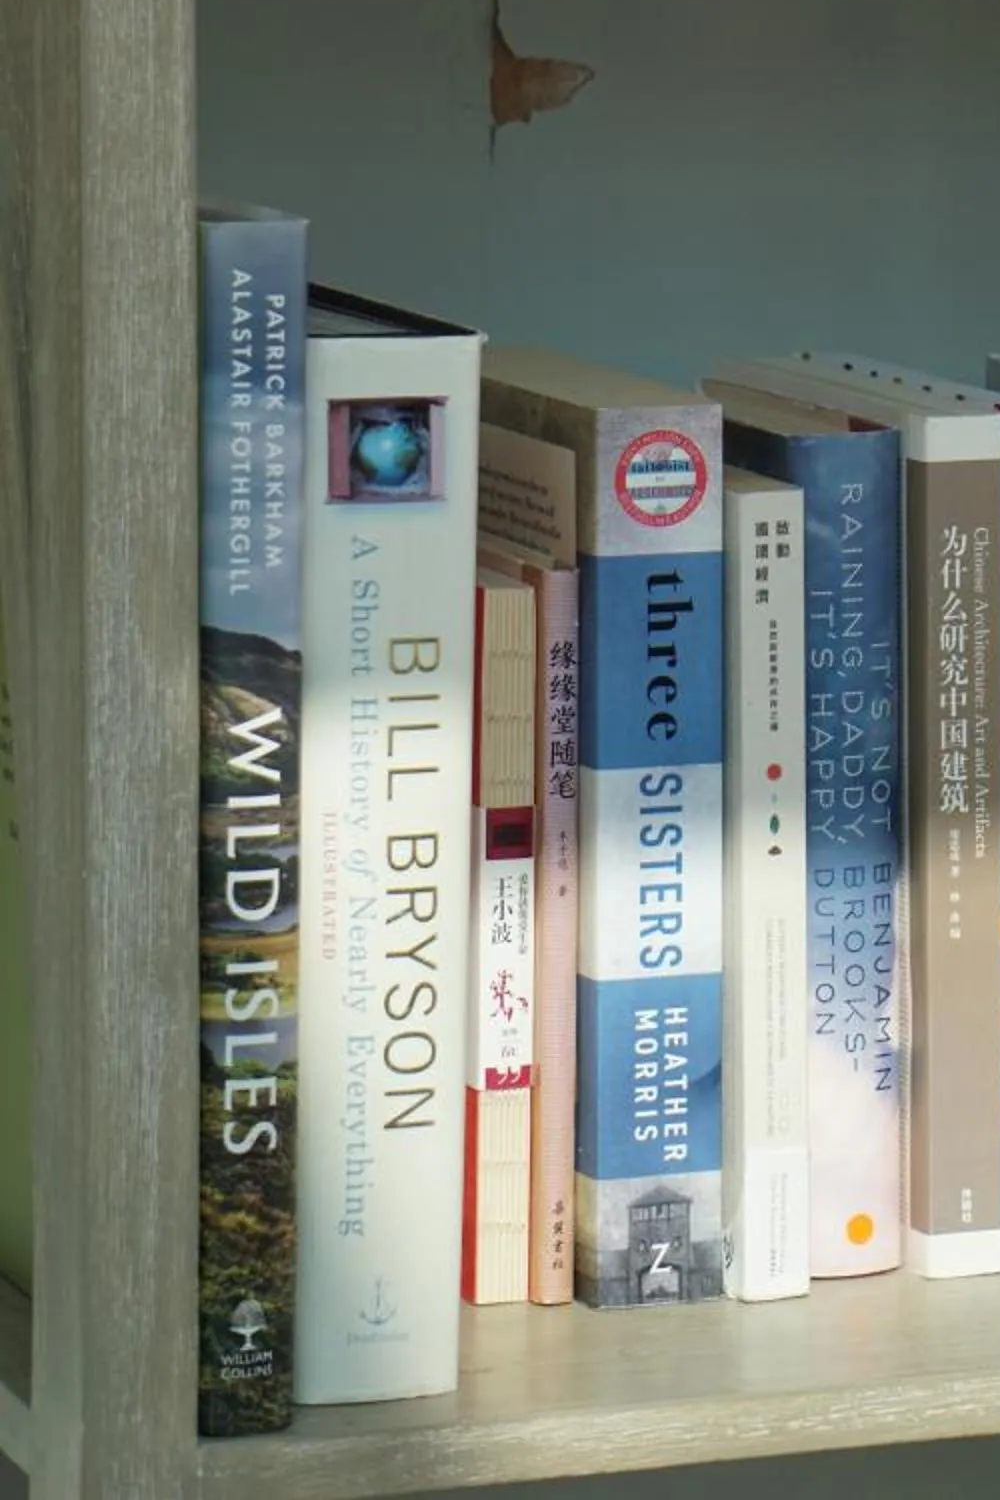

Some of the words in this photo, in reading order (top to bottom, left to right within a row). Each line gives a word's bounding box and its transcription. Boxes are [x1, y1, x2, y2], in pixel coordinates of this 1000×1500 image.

[231, 269, 252, 408] ALASTAIR
[265, 293, 286, 411] PATRICK
[229, 420, 252, 597] FOTHERGILL
[264, 424, 285, 569] BARKHAM
[350, 533, 381, 561] A
[973, 527, 989, 593] Chinese
[351, 579, 381, 677] Short
[811, 590, 837, 669] IT'S
[837, 483, 864, 677] RAINING,
[387, 637, 441, 801] BILL
[646, 568, 694, 742] three
[870, 641, 892, 720] IT'S
[939, 524, 970, 815] 为什么研究中国建筑
[342, 695, 380, 832] History
[810, 693, 835, 840] HAPPY
[837, 691, 865, 845] DADDY,
[870, 745, 892, 832] NOT
[973, 713, 990, 744] Art
[973, 747, 990, 778] and
[225, 706, 284, 922] WILD
[349, 847, 379, 884] of
[639, 773, 683, 969] SISTERS
[341, 894, 378, 1015] Nearly
[383, 832, 439, 1131] BRYSON
[814, 866, 835, 1036] DUTTON
[842, 865, 866, 1073] BROOKS-
[872, 862, 893, 1092] BENJAMIN
[222, 960, 280, 1155] ISLES
[633, 1009, 659, 1142] MORRIS
[663, 1007, 688, 1162] HEATHER
[338, 1034, 376, 1238] Everything
[220, 1349, 273, 1365] WILLIAM
[220, 1363, 273, 1380] COLLINS
